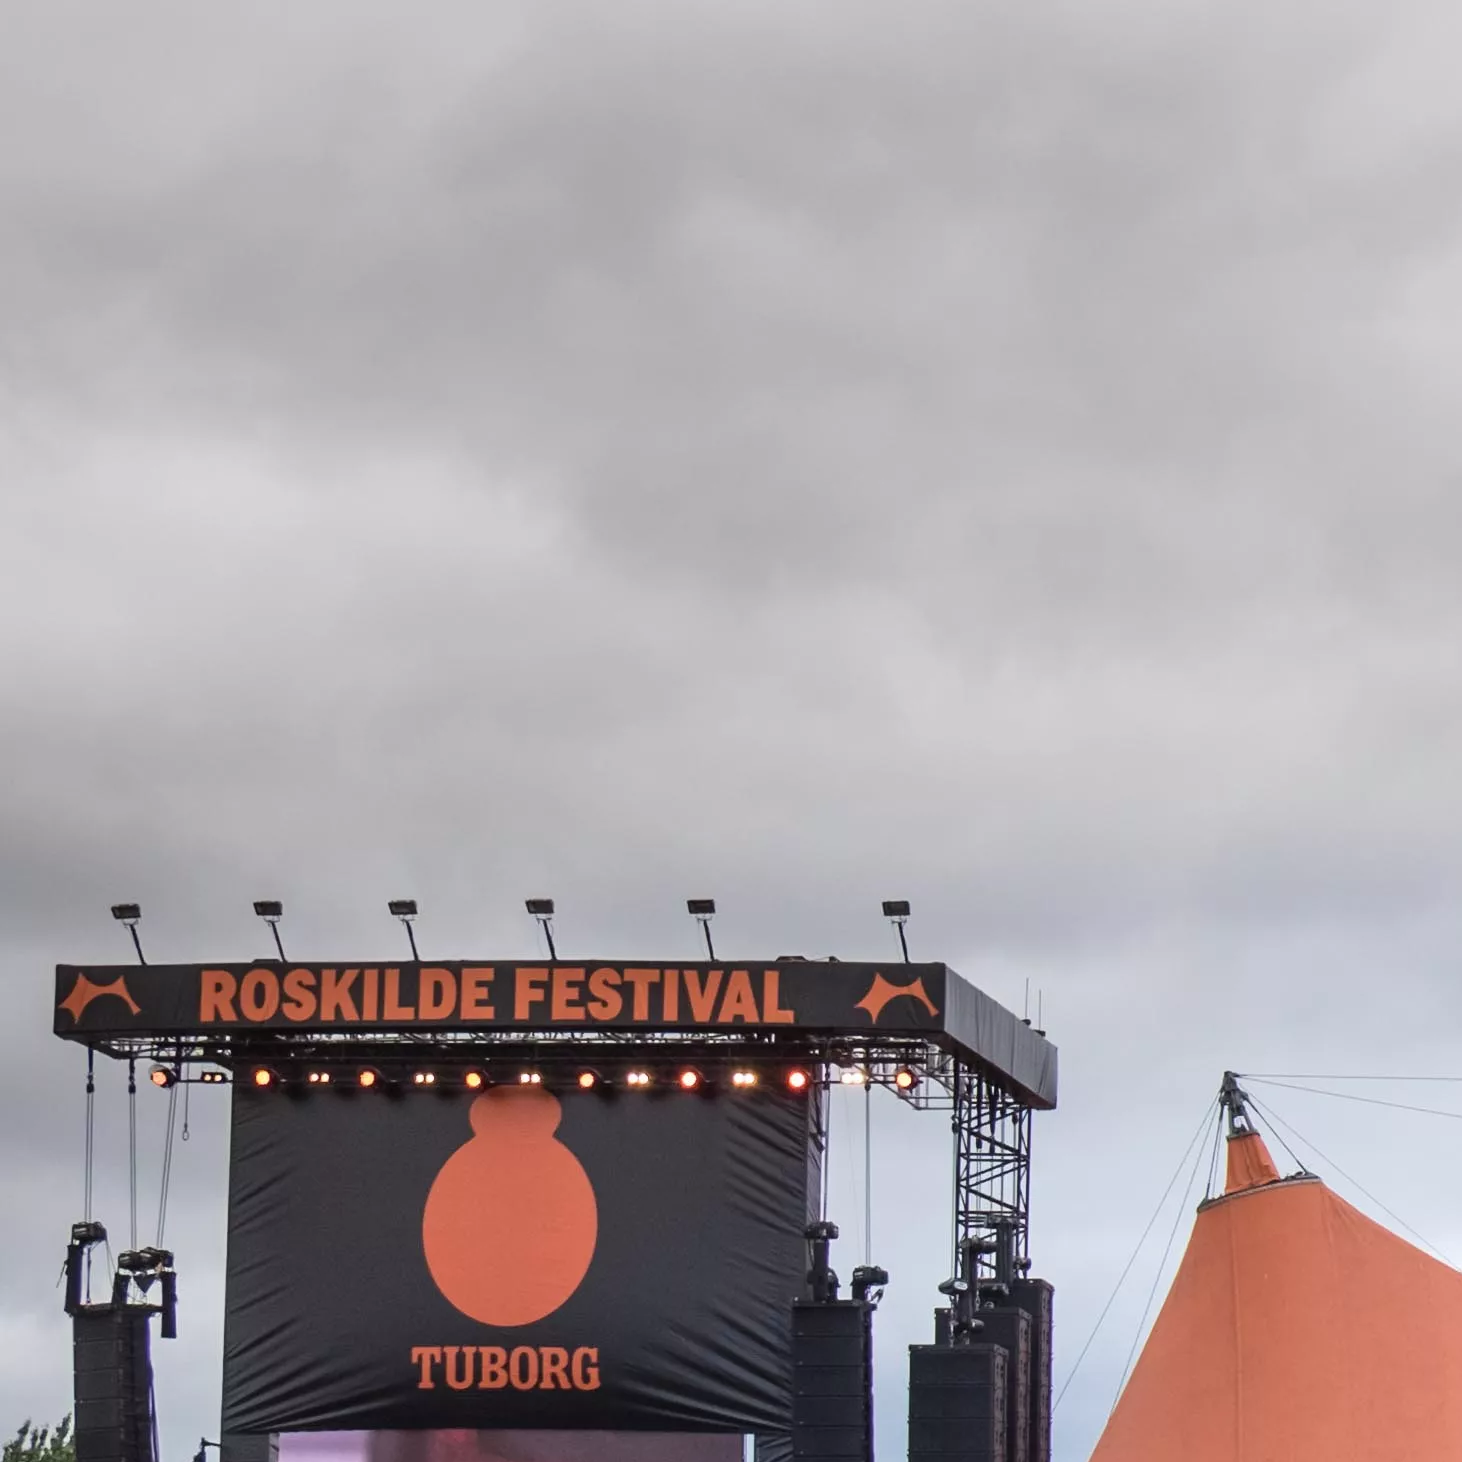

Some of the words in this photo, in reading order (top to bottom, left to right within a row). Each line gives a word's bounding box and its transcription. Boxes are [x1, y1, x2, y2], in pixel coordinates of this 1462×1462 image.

[200, 967, 494, 1022] ROSKILDE
[514, 967, 794, 1024] FESTIVAL
[411, 1346, 600, 1390] TUBORG
